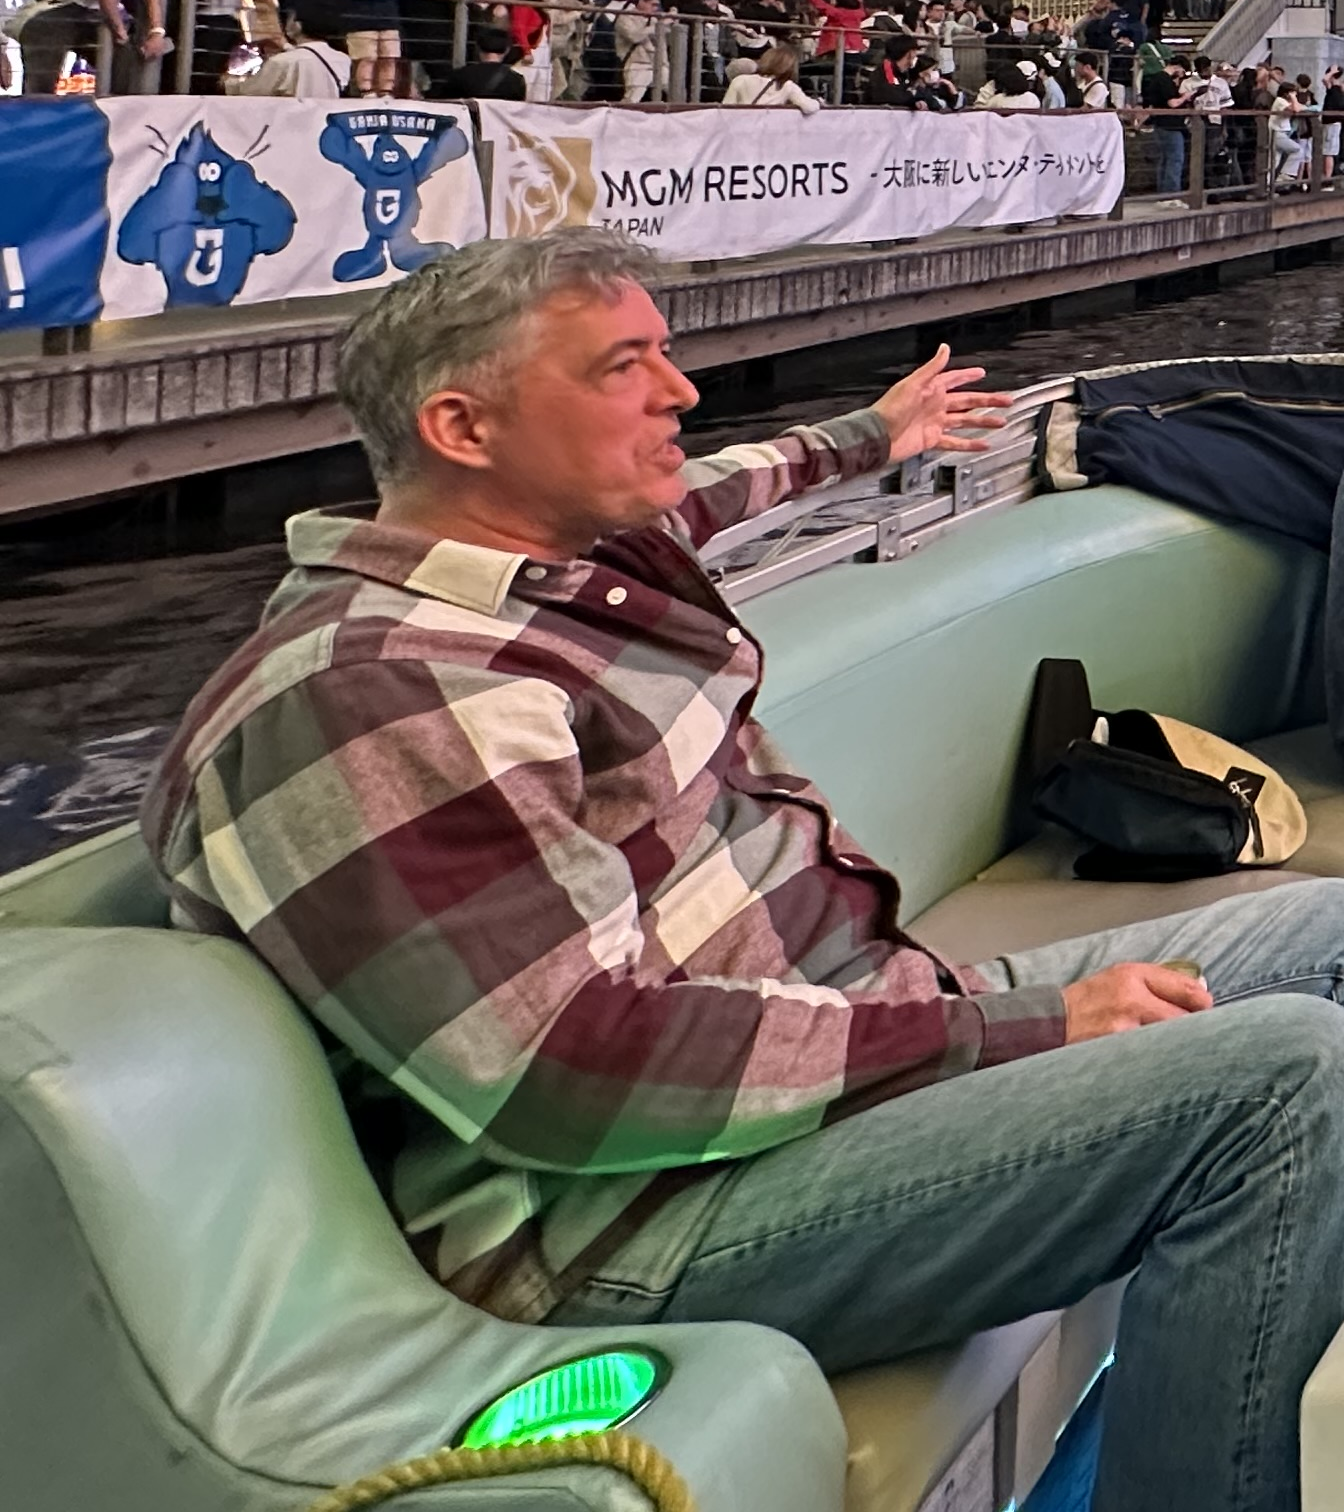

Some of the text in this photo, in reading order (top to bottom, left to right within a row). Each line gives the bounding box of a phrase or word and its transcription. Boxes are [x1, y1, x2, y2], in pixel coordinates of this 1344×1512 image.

[391, 114, 436, 132] OSAKA
[601, 161, 849, 209] MGM RESORTS
